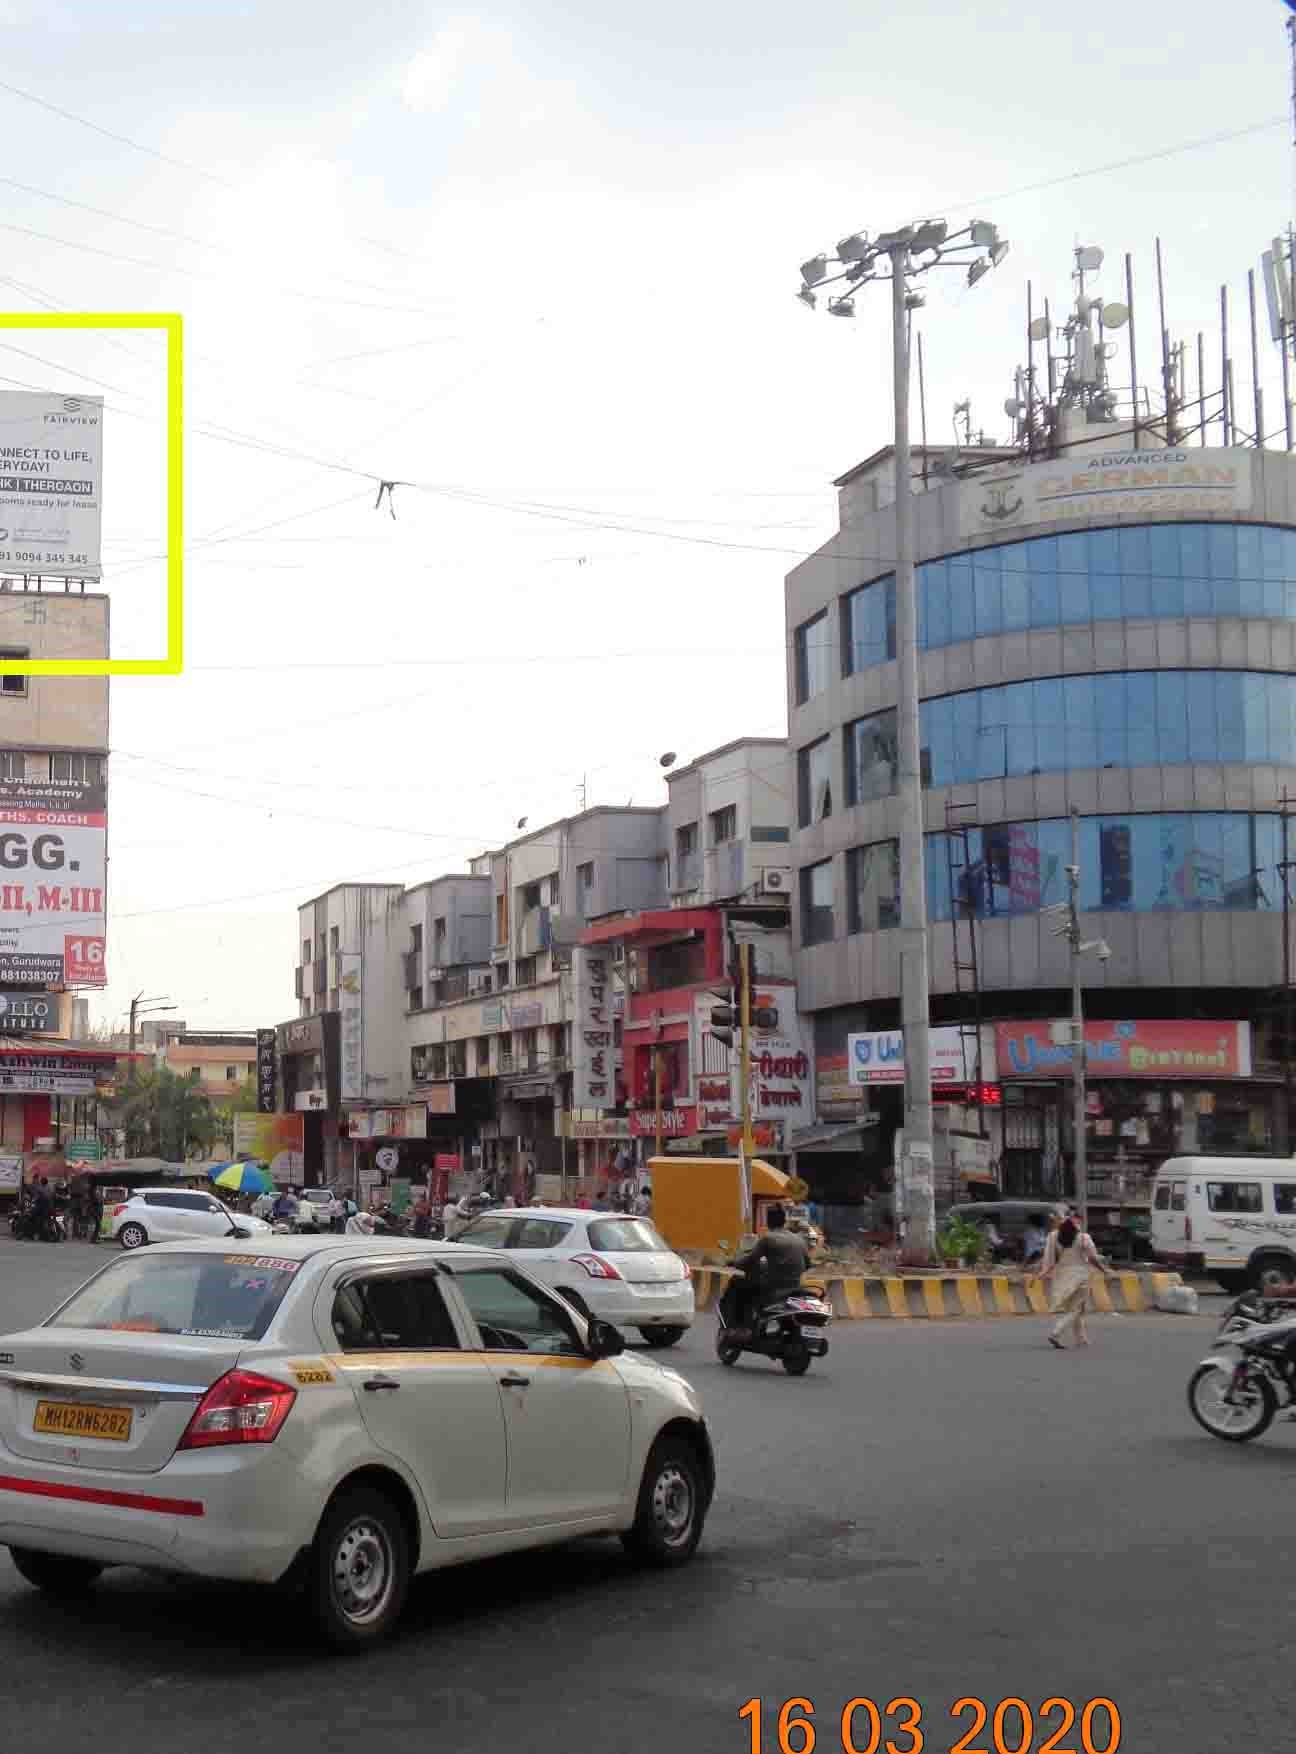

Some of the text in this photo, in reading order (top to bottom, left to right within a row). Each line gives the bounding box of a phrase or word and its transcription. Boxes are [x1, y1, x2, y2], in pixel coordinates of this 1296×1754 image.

[43, 415, 98, 425] FAIRVIEW
[43, 448, 61, 461] TO
[1087, 452, 1188, 469] ADVANCED
[23, 480, 91, 493] THERGAON
[16, 787, 84, 800] Academy
[36, 811, 88, 825] COACH
[37, 883, 104, 914] M-III
[70, 941, 103, 963] 16
[11, 956, 61, 968] Gurudwara
[636, 1110, 686, 1131] Supe Style
